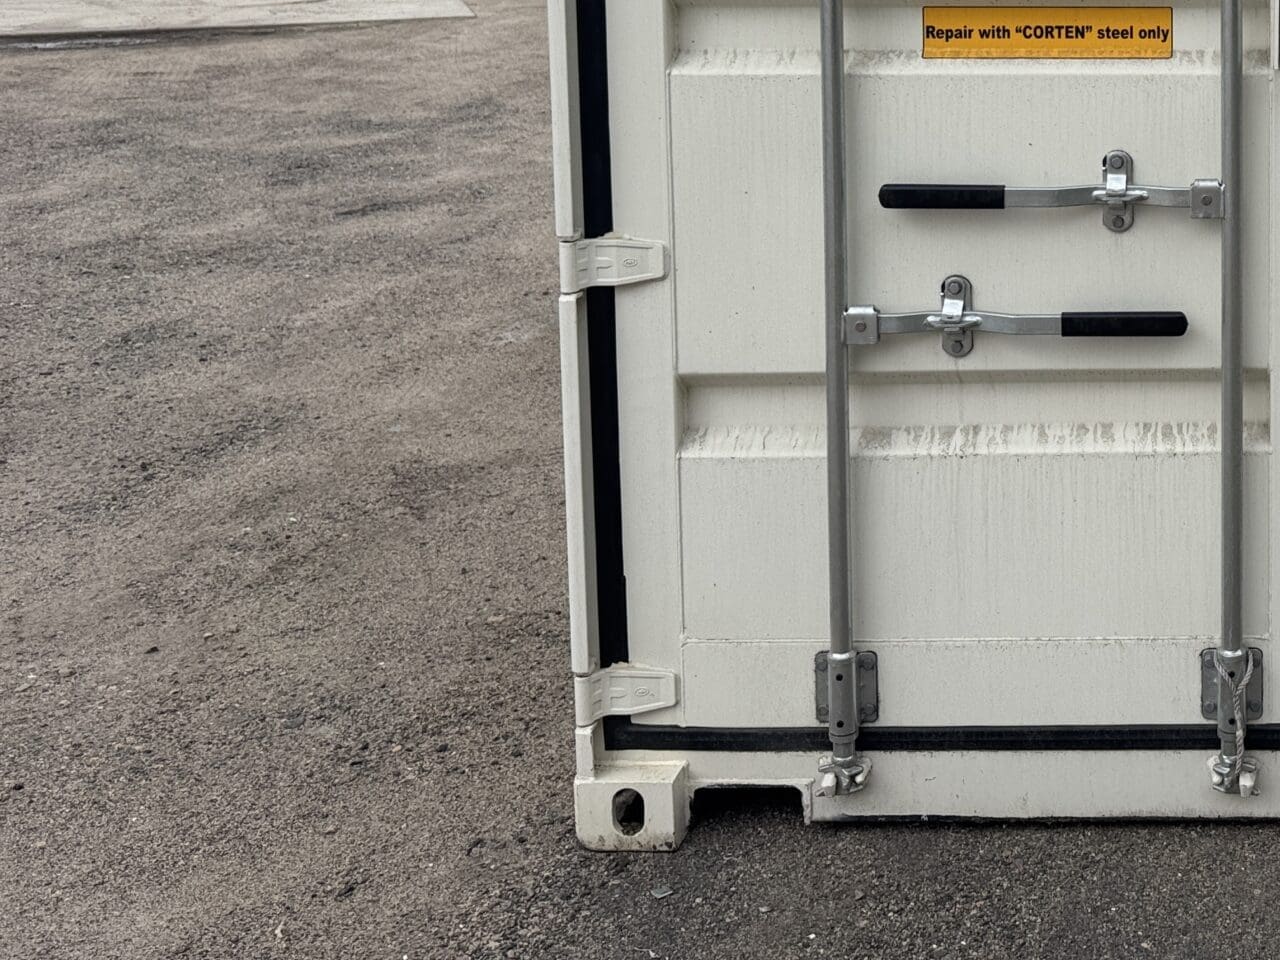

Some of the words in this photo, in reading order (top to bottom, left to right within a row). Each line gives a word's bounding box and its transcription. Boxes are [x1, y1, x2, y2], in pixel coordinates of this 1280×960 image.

[925, 25, 974, 42] Repair
[978, 25, 1010, 39] with
[1015, 25, 1093, 39] “CORTEN”
[1097, 25, 1134, 39] steel
[1138, 25, 1169, 42] only
